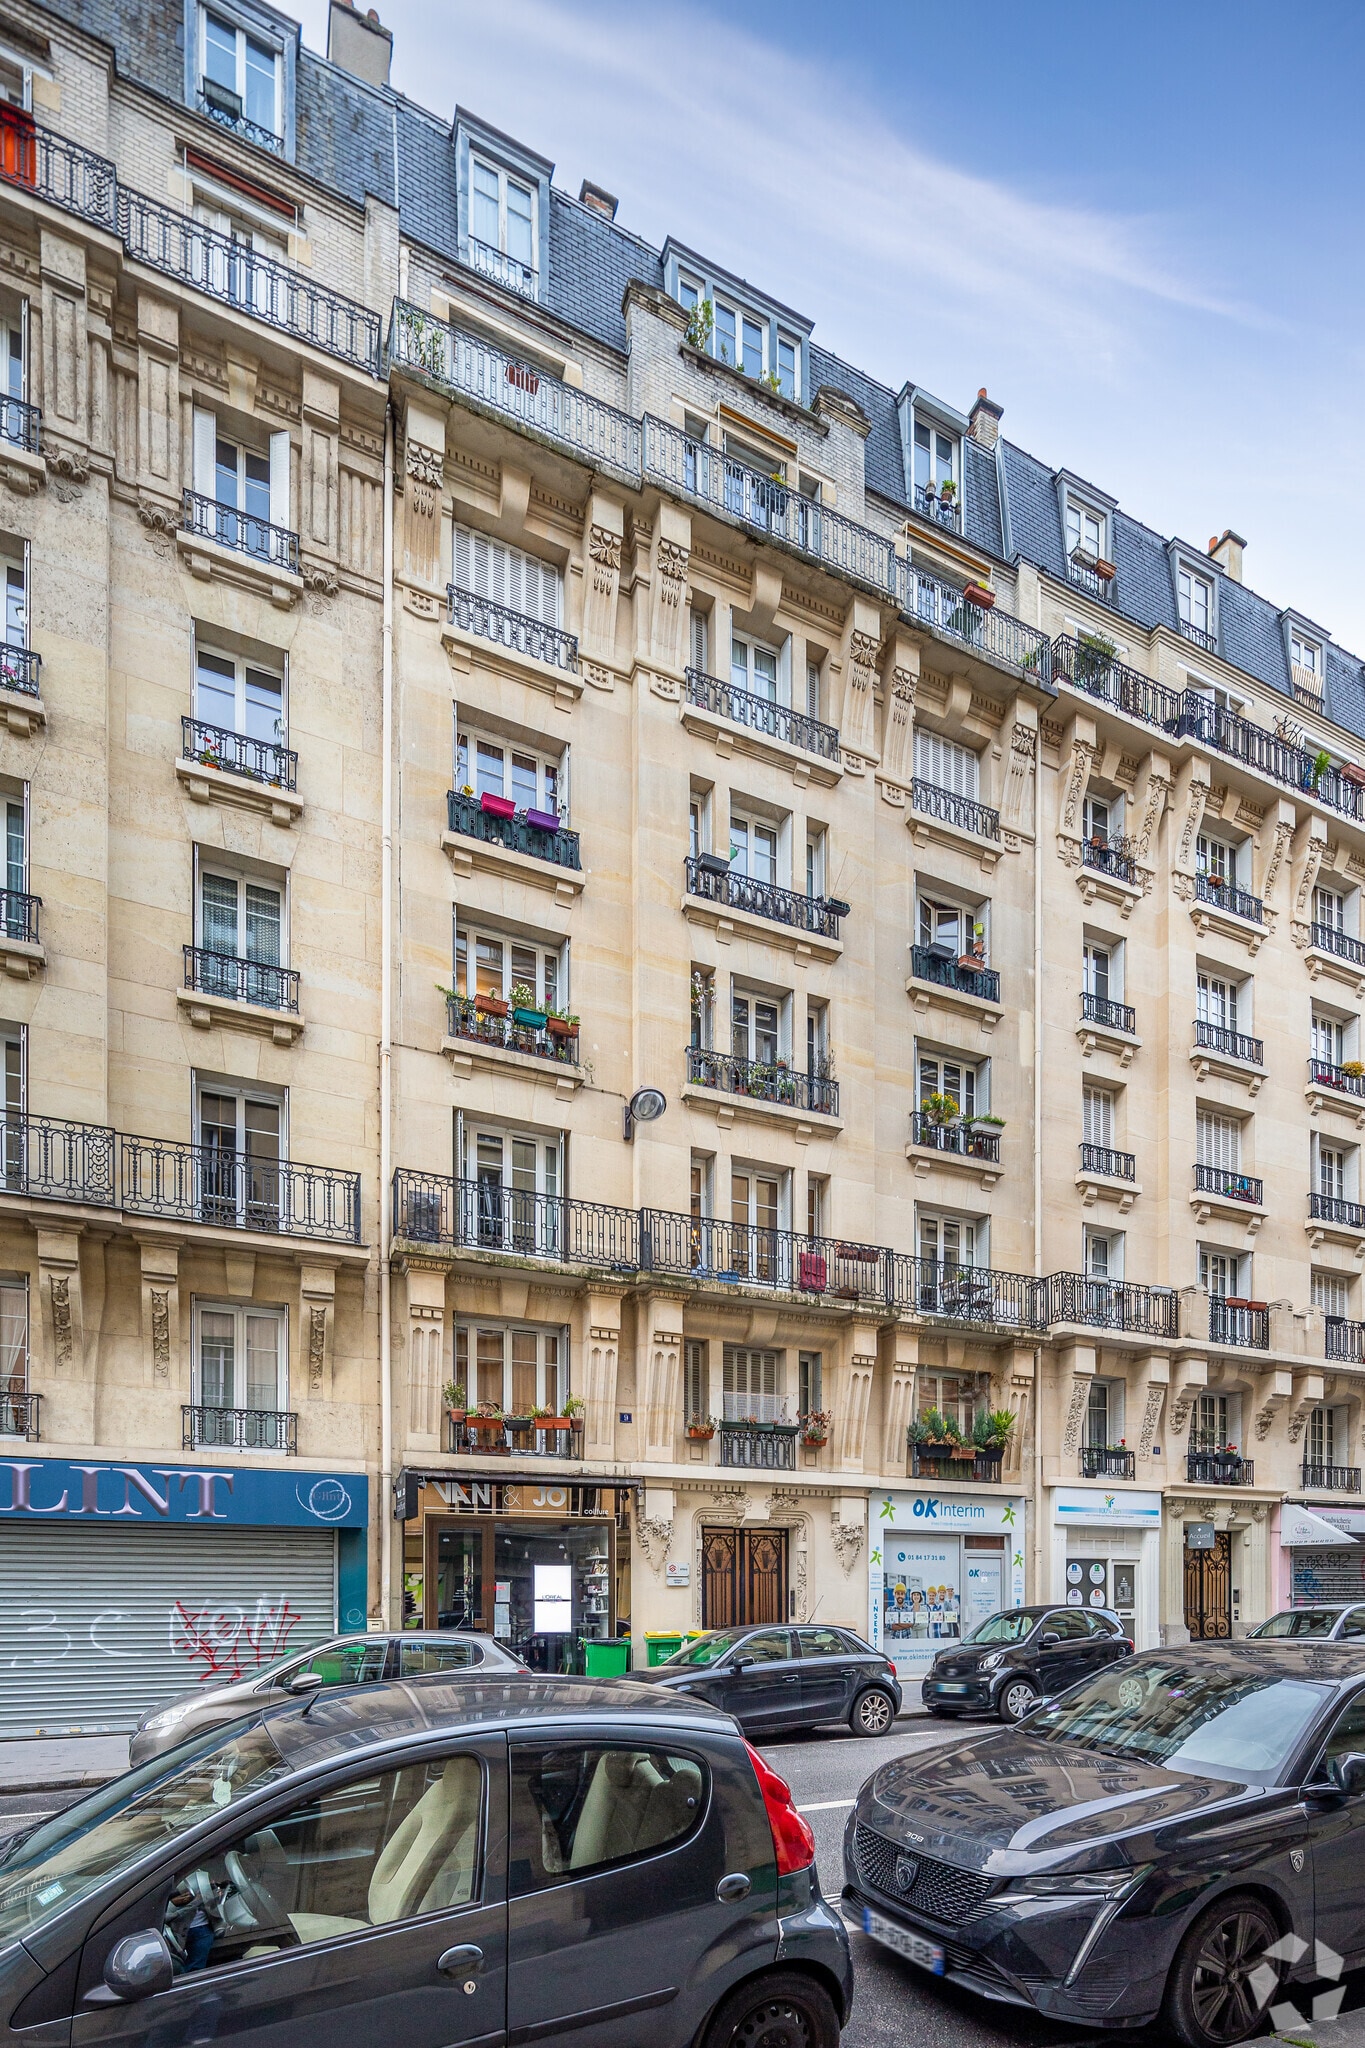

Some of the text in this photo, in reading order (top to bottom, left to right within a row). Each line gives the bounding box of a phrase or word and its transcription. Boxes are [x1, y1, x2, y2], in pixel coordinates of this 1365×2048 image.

[0, 1462, 234, 1518] LINT
[432, 1481, 567, 1507] VAN & JO
[583, 1508, 609, 1516] coiffure
[913, 1497, 985, 1518] OK Interim
[968, 1569, 980, 1577] OK
[905, 1830, 924, 1843] 308
